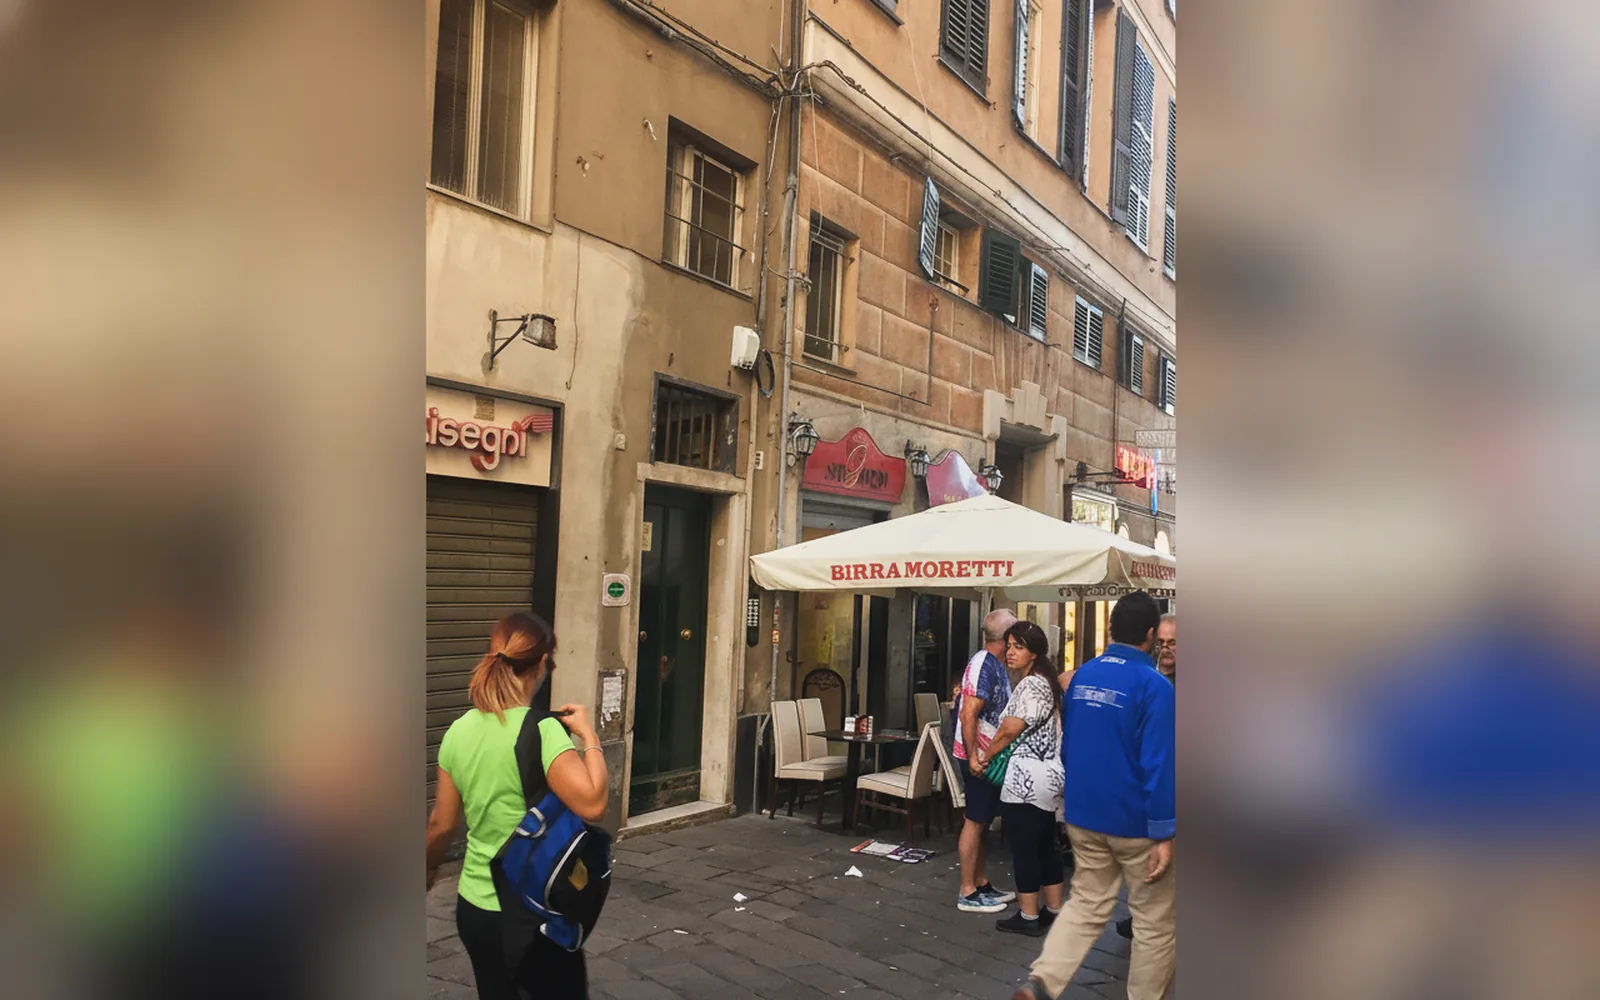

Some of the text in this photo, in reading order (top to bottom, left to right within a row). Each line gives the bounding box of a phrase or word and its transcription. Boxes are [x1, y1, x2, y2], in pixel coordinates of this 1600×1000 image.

[426, 407, 527, 471] isegni
[830, 560, 1015, 581] BIRRA MORETTI
